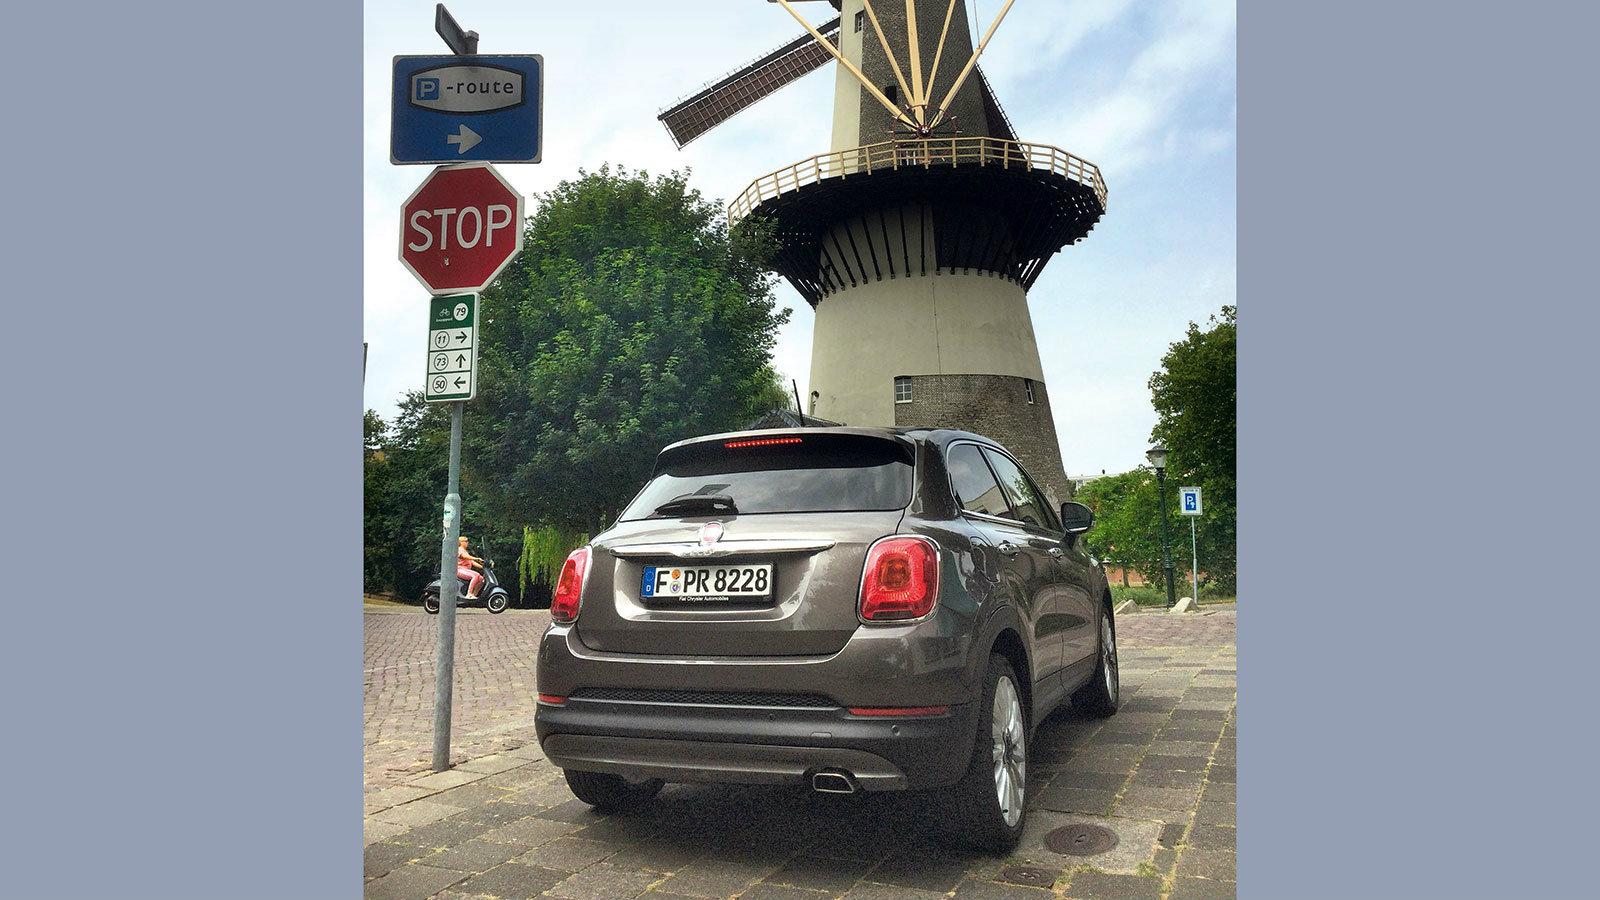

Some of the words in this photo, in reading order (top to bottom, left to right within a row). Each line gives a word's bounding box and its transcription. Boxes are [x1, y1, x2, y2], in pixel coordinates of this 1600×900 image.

[420, 81, 436, 98] P
[446, 81, 514, 94] -route
[408, 204, 512, 252] STOP
[456, 307, 466, 317] 79
[437, 335, 447, 344] 11
[436, 357, 447, 367] 73
[435, 380, 446, 390] 50
[655, 571, 670, 593] F
[683, 569, 710, 593] PR
[713, 568, 768, 592] 8228
